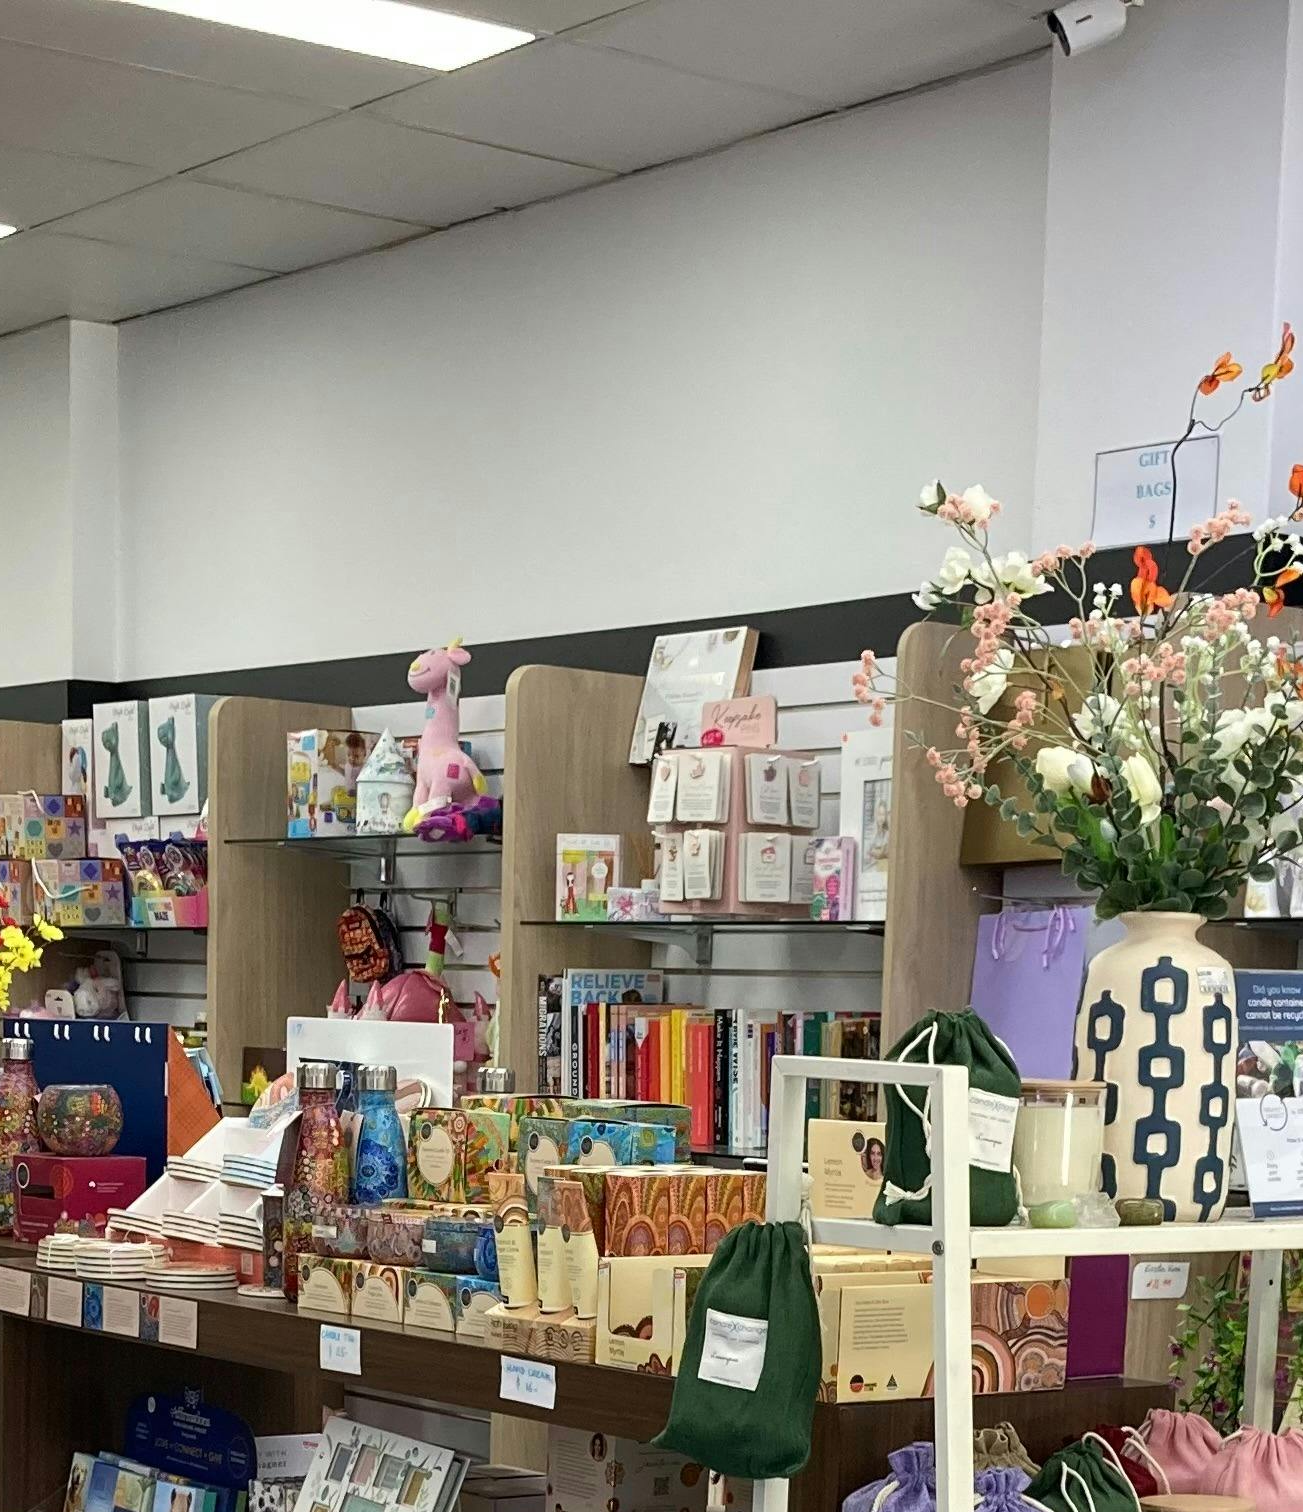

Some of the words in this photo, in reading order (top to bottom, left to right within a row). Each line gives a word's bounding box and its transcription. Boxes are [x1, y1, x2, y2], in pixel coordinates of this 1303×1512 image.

[1138, 449, 1170, 468] GIFT
[1136, 480, 1172, 499] BAGS
[571, 973, 645, 989] RELIEVE
[571, 990, 620, 1004] BACK
[1266, 986, 1280, 996] you
[1282, 985, 1301, 994] know
[1248, 999, 1272, 1007] candle
[1246, 1011, 1271, 1020] cannot
[1272, 1010, 1282, 1019] be
[538, 996, 547, 1056] MIGRATIONS
